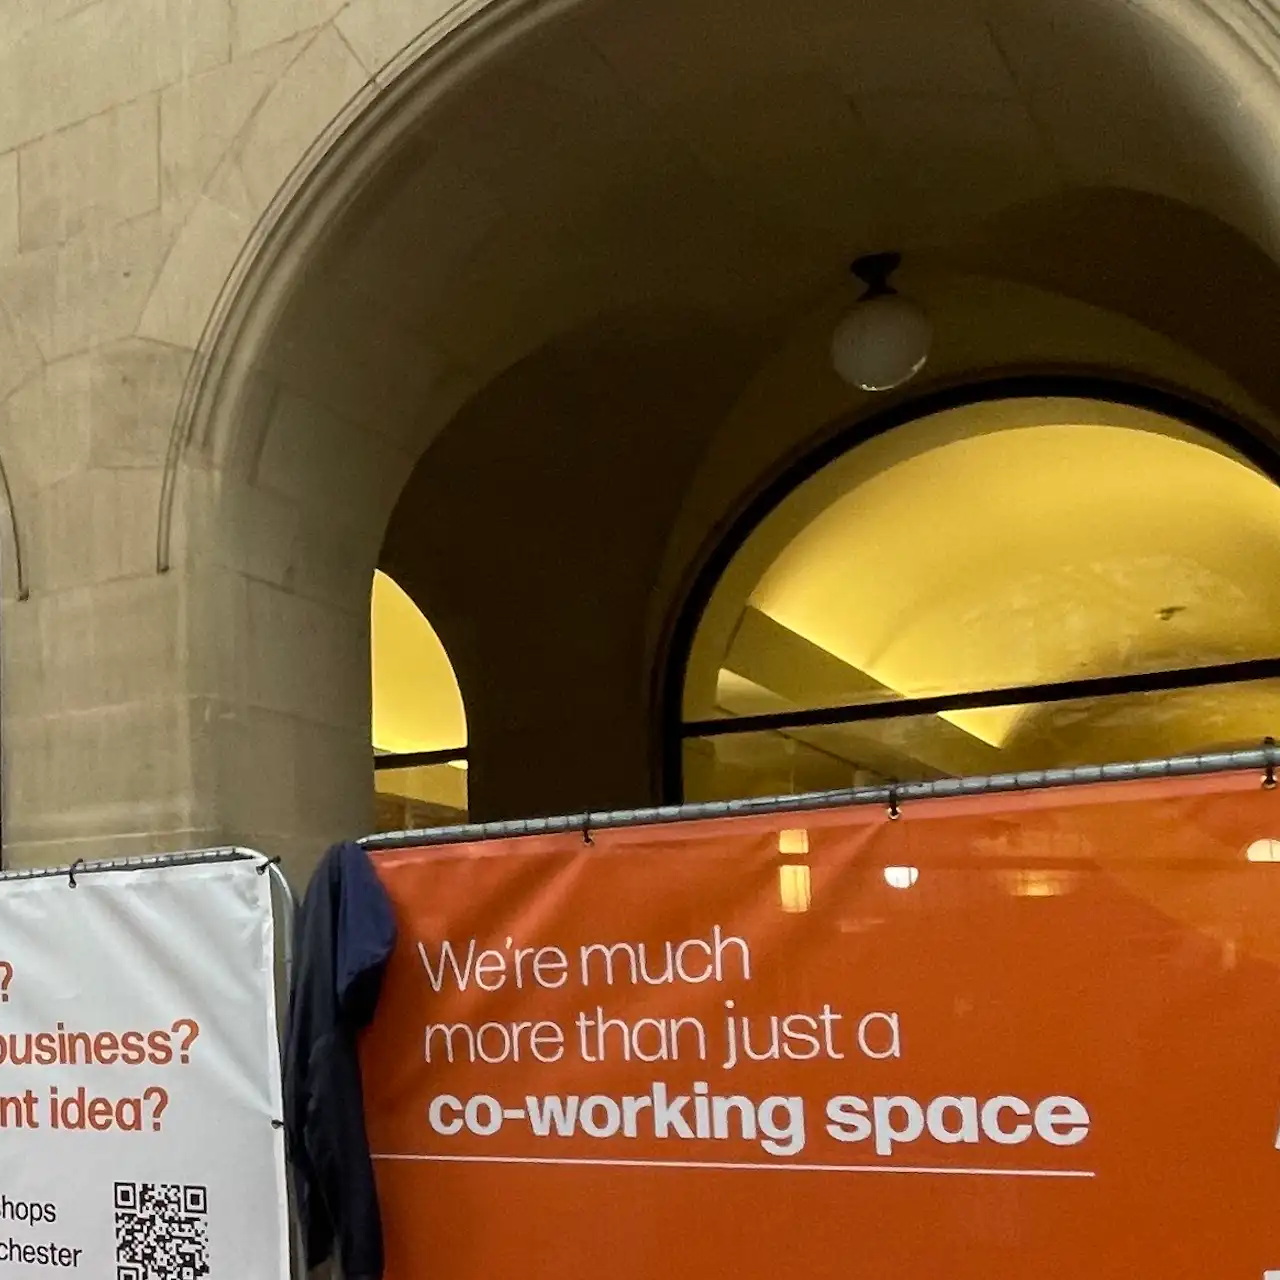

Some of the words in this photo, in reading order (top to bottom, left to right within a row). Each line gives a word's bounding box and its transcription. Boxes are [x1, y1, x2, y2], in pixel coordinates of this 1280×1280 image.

[417, 936, 568, 992] We're
[580, 924, 751, 986] much
[424, 1020, 564, 1064] more
[575, 1006, 706, 1062] than
[722, 999, 846, 1070] just
[857, 1011, 901, 1060] a
[49, 1086, 170, 1132] idea?
[428, 1081, 807, 1156] co-working
[825, 1095, 1091, 1156] space
